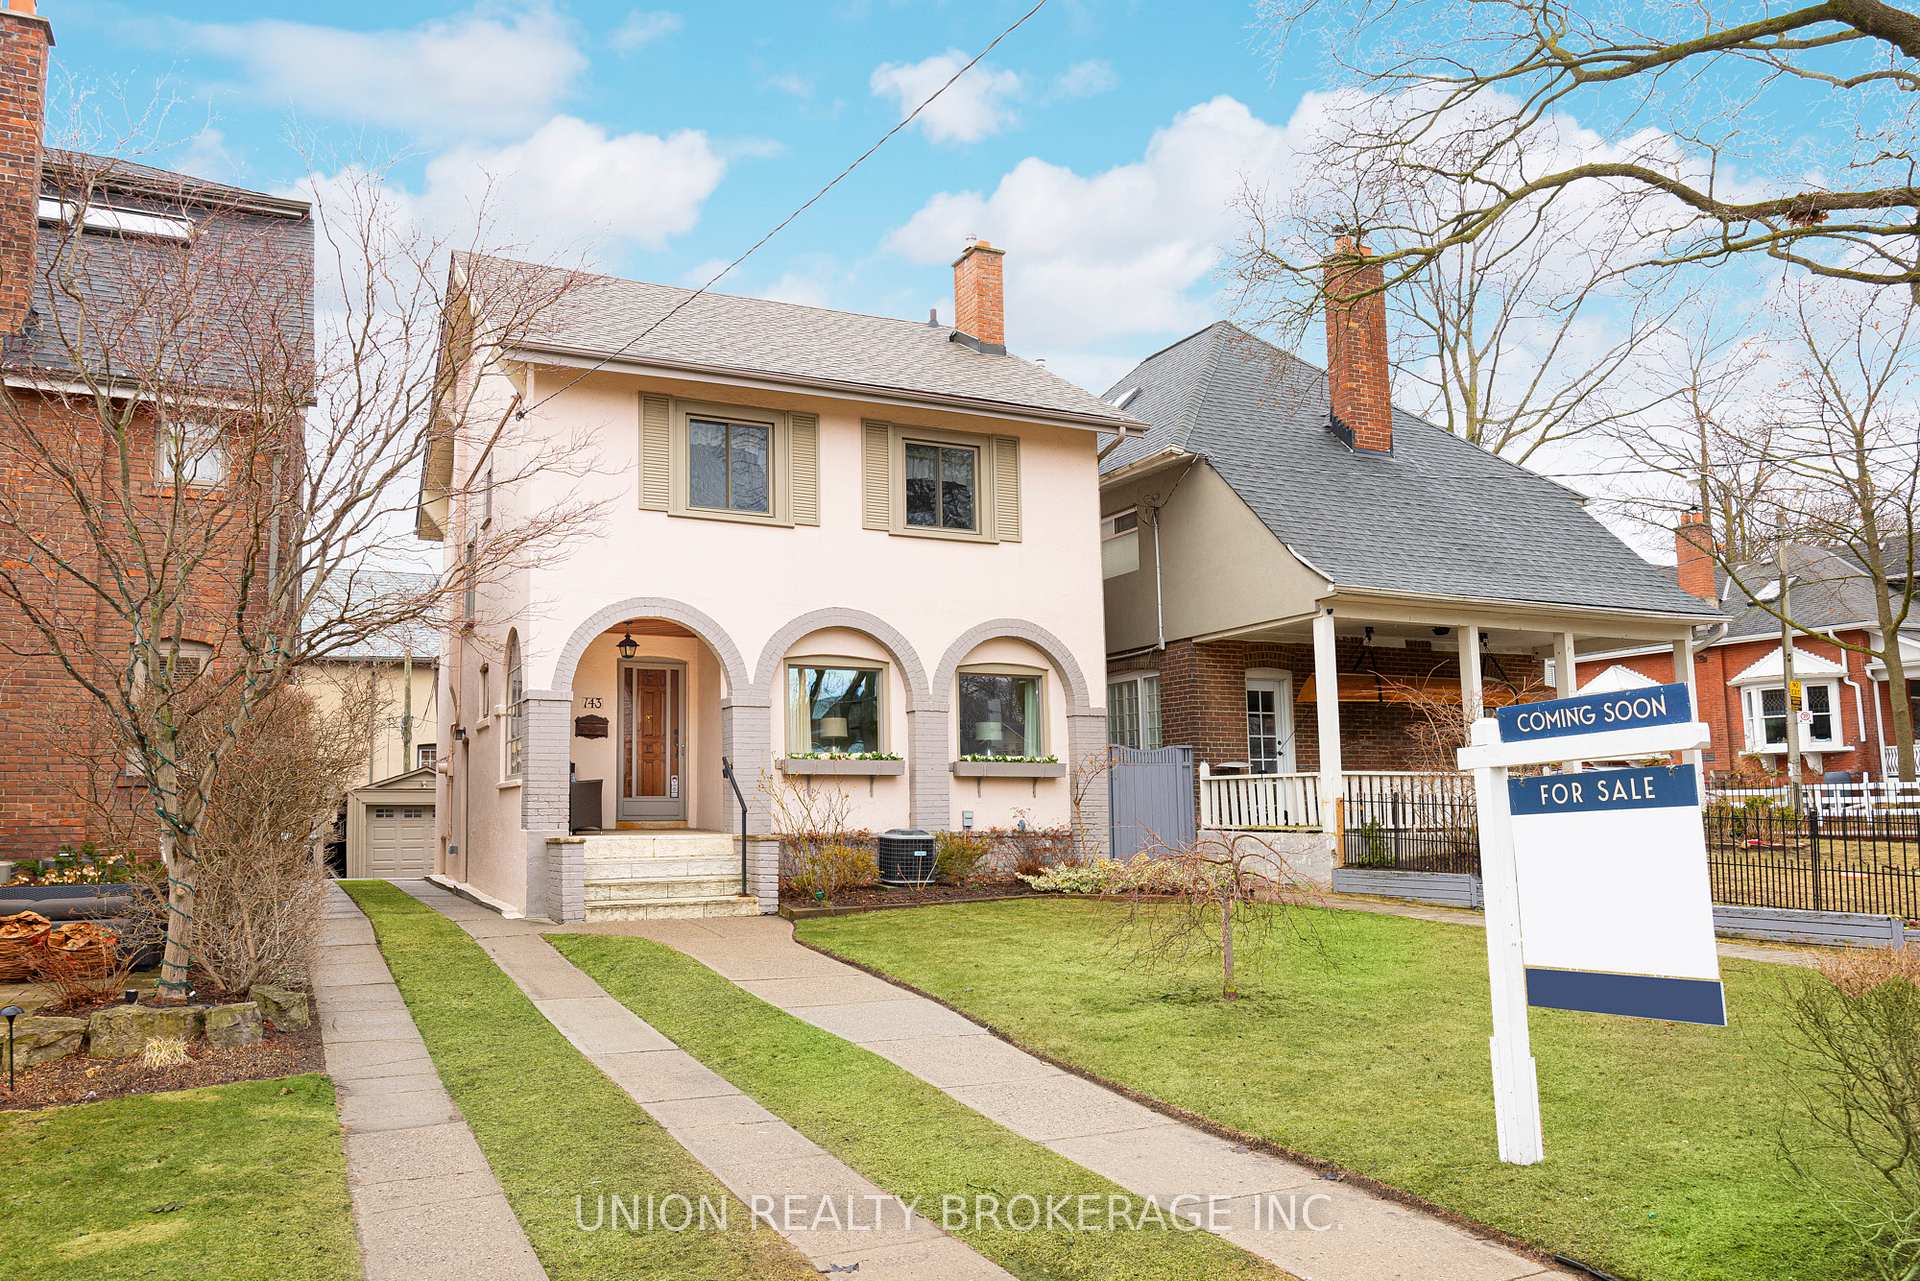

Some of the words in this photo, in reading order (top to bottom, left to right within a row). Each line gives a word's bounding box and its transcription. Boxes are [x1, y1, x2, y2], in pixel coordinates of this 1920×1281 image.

[583, 697, 602, 709] 743
[1517, 705, 1596, 733] COMING
[1603, 694, 1667, 723] SOON
[1540, 783, 1584, 806] FOR
[1597, 776, 1656, 802] SALE
